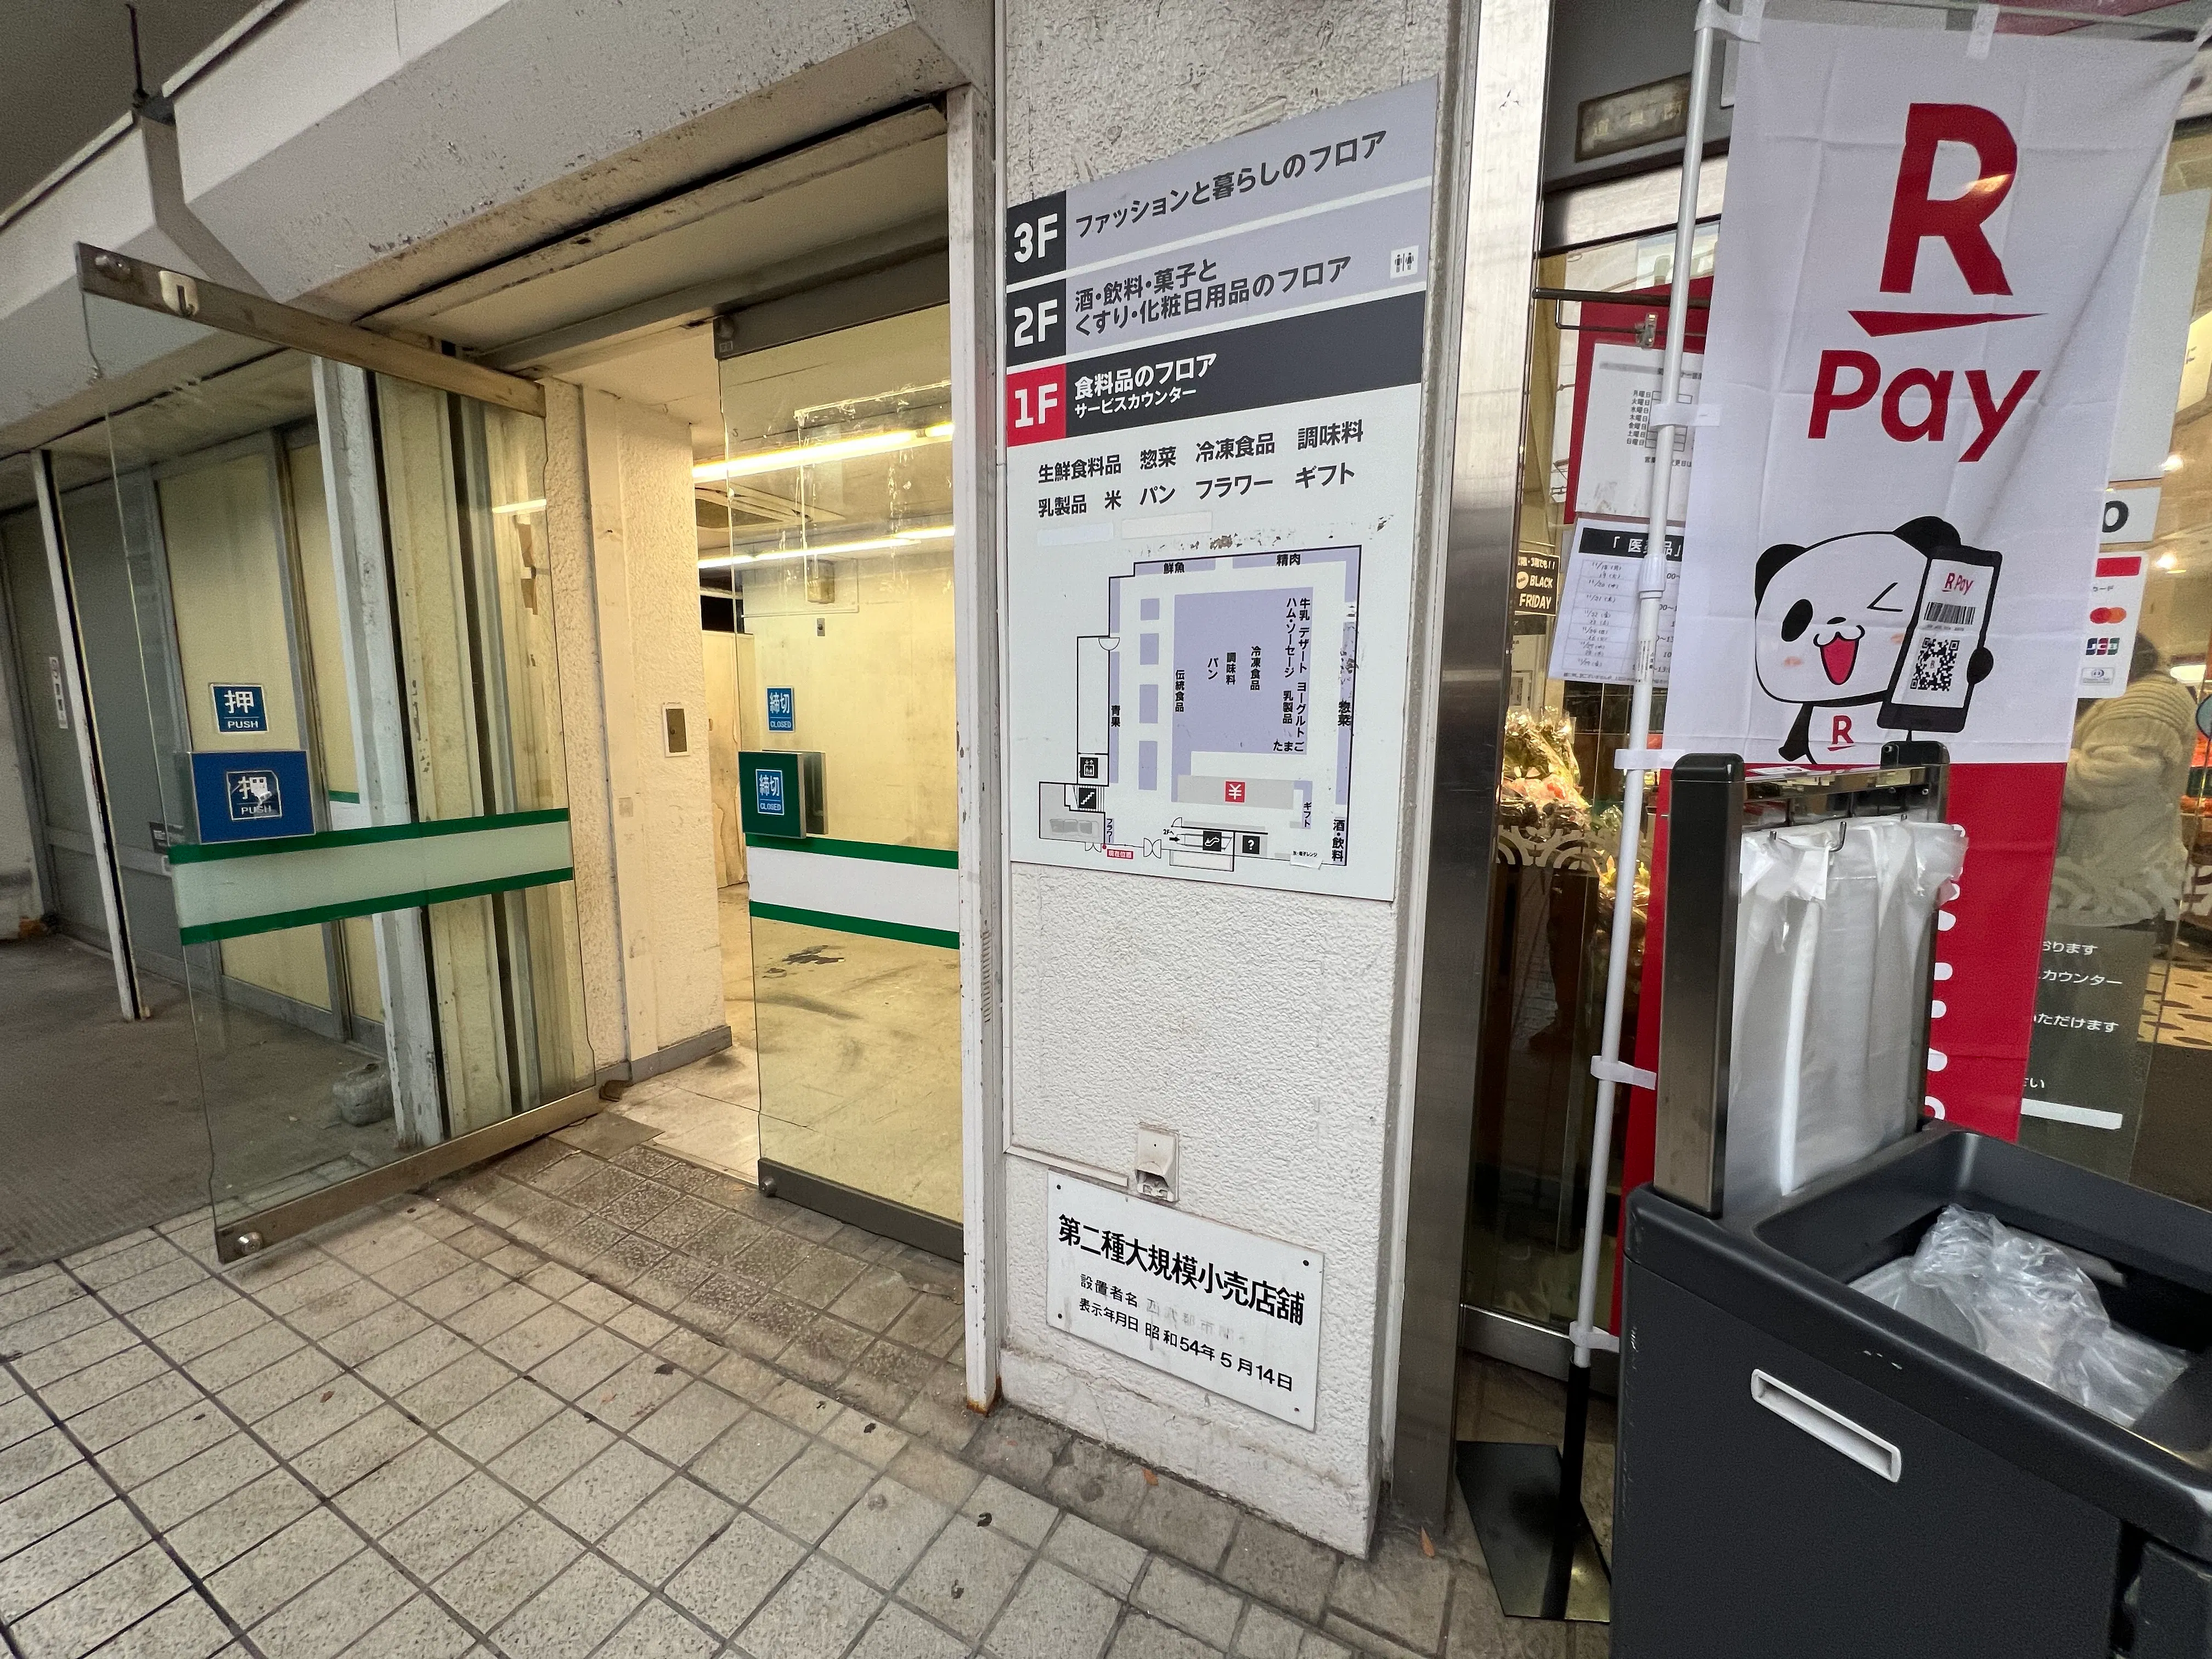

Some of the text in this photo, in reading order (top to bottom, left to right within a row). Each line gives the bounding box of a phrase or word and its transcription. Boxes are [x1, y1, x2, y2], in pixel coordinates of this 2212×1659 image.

[1076, 129, 1387, 240] ファッションと暮らしのフロア
[1880, 103, 2018, 296] R
[1013, 213, 1059, 264] 3F
[1075, 259, 1218, 313] 酒・飲料・菓子と
[1076, 255, 1352, 336] くすり・化粧日用品のフロア
[1013, 301, 1059, 348] 2F
[1074, 352, 1218, 402] 食料品のフロア
[1014, 382, 1059, 429] 1F
[1074, 389, 1197, 419] サービスカウンター
[1808, 349, 2041, 462] Pay
[1037, 419, 1363, 484] 生鮮食料品 惣菜 冷凍食品 調味料
[1037, 462, 1355, 518] 乳製品 米 パン フラワー ギフト
[1163, 562, 1186, 574] 鮮魚
[1276, 554, 1301, 566] 精肉
[1529, 575, 1554, 589] BLACK
[1519, 592, 1552, 610] FRIDAY
[1207, 657, 1219, 680] パン
[1225, 652, 1237, 685] 調味料
[1250, 645, 1261, 691] 冷凍食品
[1282, 597, 1297, 724] ハム・ソーセージ 乳製品
[1295, 597, 1311, 738] 牛乳 デザート ヨーグルト
[223, 690, 255, 714] 押
[769, 692, 790, 714] 締切
[1175, 669, 1185, 712] 伝統食品
[227, 720, 259, 729] PUSH
[770, 720, 792, 729] CLOSED
[1832, 714, 1855, 745] R
[1273, 741, 1304, 752] たまご
[759, 774, 780, 797] 締切
[240, 806, 272, 815] PUSH
[760, 803, 781, 811] CLOSED
[1303, 802, 1312, 828] ギフト
[1331, 819, 1346, 862] 酒・飲料
[2039, 969, 2123, 986] カウンター
[1058, 1214, 1306, 1326] 第二種大規模小売店舗
[1080, 1273, 1138, 1308] 設置者名
[1079, 1297, 1139, 1333] 表示年月日
